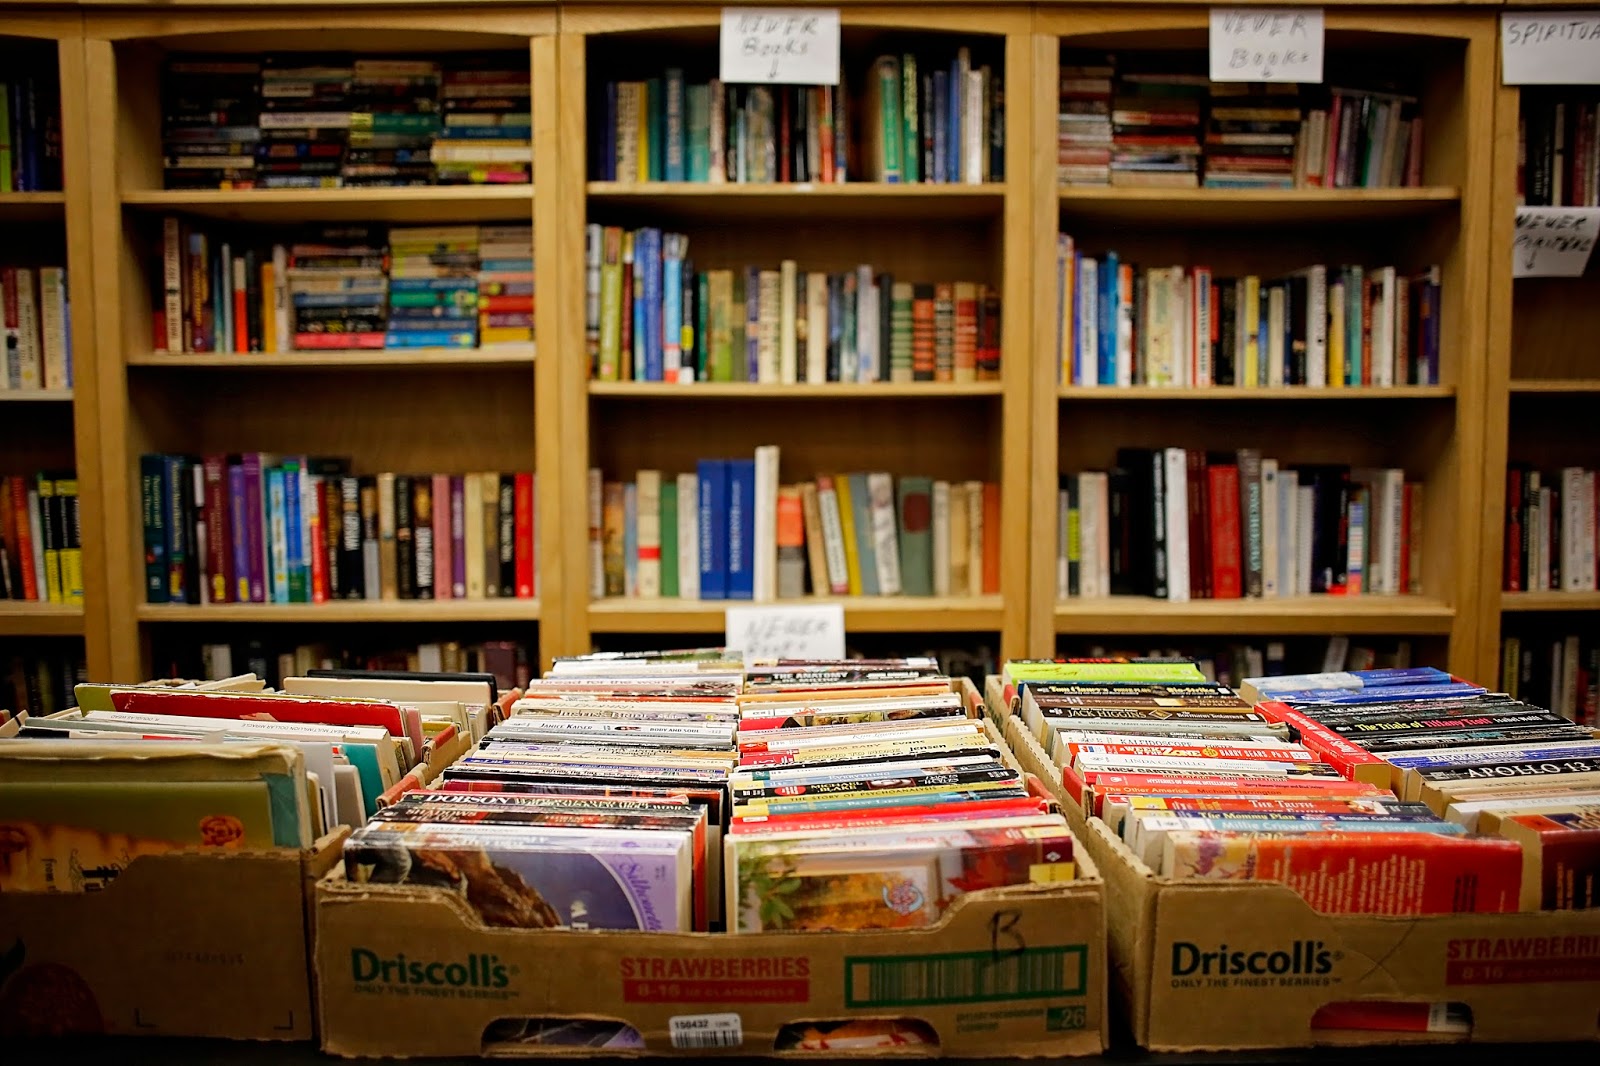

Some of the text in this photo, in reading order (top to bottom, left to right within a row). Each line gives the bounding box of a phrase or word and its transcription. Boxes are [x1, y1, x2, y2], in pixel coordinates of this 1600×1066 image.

[1067, 709, 1096, 718] JACK
[1098, 710, 1147, 719] HIGGINS
[1355, 723, 1376, 731] The
[1376, 721, 1410, 730] Trials
[1411, 720, 1424, 728] of
[1422, 719, 1465, 728] Tiffany
[910, 743, 947, 751] Jensen
[1120, 738, 1192, 747] KALEIDOSCOPE
[1162, 747, 1202, 757] ZONE
[1219, 749, 1242, 757] BARRY
[1468, 761, 1591, 778] APOLLO 13
[810, 781, 863, 789] MICHAEL
[812, 793, 839, 801] STORY
[861, 786, 937, 797] PSYCHOANALYSIS
[1234, 789, 1281, 797] Harrington
[426, 794, 510, 806] DOBSON
[1248, 800, 1314, 809] THE TRUTH
[406, 808, 477, 817] SHADOWS
[1199, 811, 1220, 819] The
[1223, 812, 1268, 821] Mommy
[800, 822, 844, 831] Nick's
[1221, 821, 1260, 831] Millie
[1262, 822, 1316, 832] Criswell
[1172, 940, 1333, 977] Driscoll's
[351, 947, 510, 988] Driscoll's
[620, 956, 810, 978] STRAWBERRIES
[1172, 978, 1202, 988] ONLY
[1206, 978, 1228, 987] THE
[1233, 978, 1276, 987] FINEST
[1061, 1008, 1085, 1028] 26
